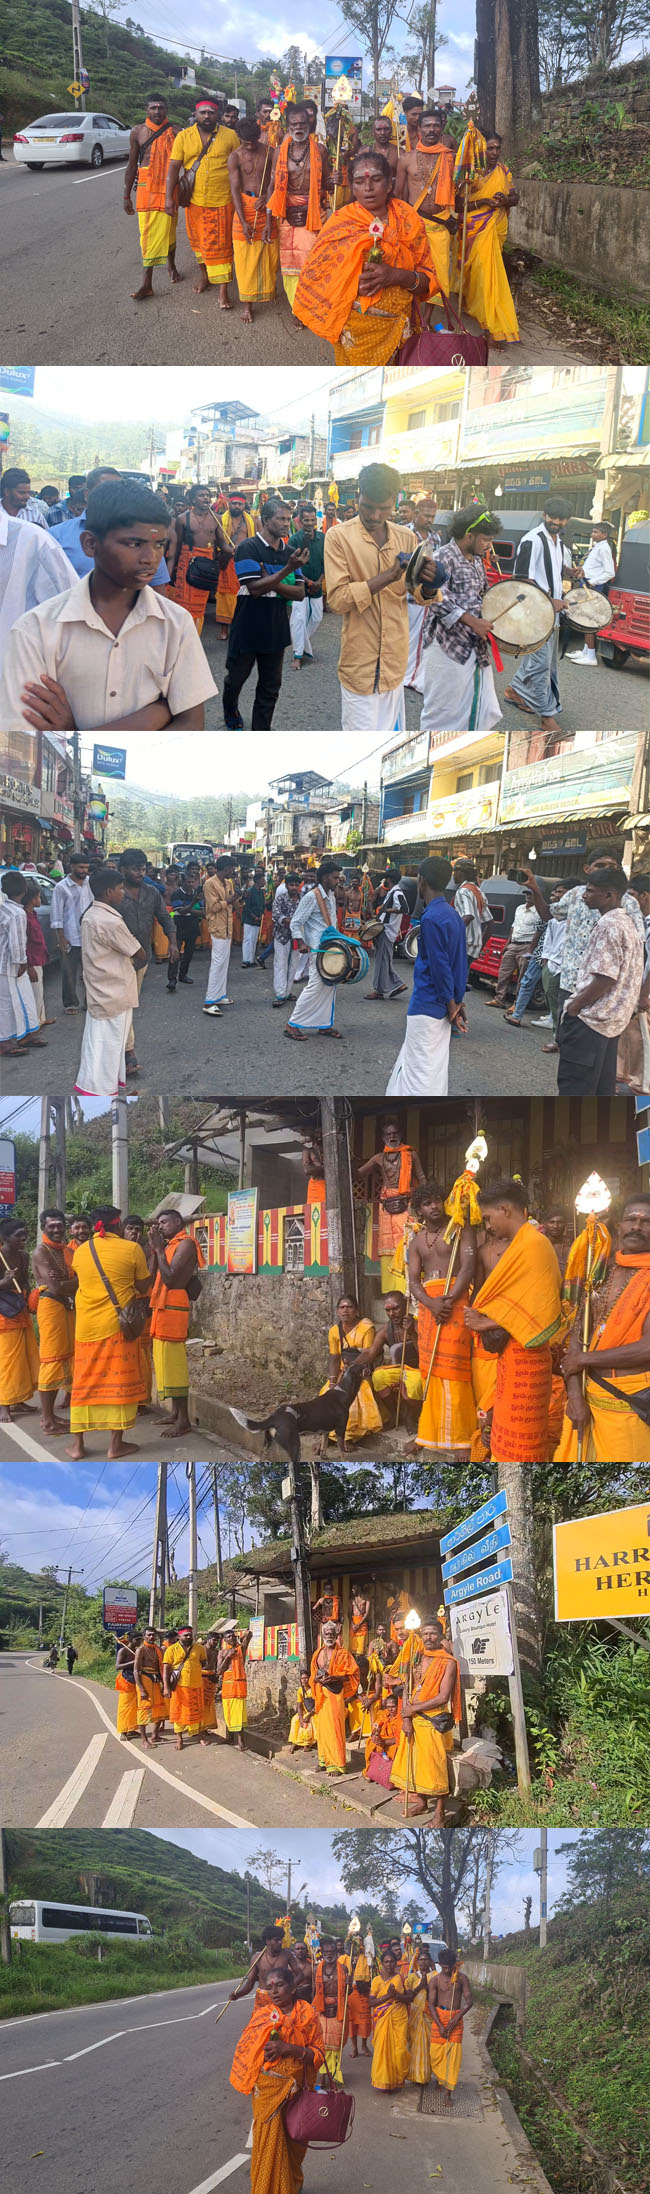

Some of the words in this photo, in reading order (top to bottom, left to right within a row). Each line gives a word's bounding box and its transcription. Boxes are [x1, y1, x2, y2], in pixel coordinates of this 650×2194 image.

[97, 754, 120, 764] Dulux
[480, 1535, 499, 1554] வீதி
[575, 1547, 650, 1572] HARR
[450, 1583, 475, 1600] Argyle
[476, 1568, 501, 1588] Road
[595, 1570, 650, 1591] HER
[477, 1657, 495, 1665] Meters
